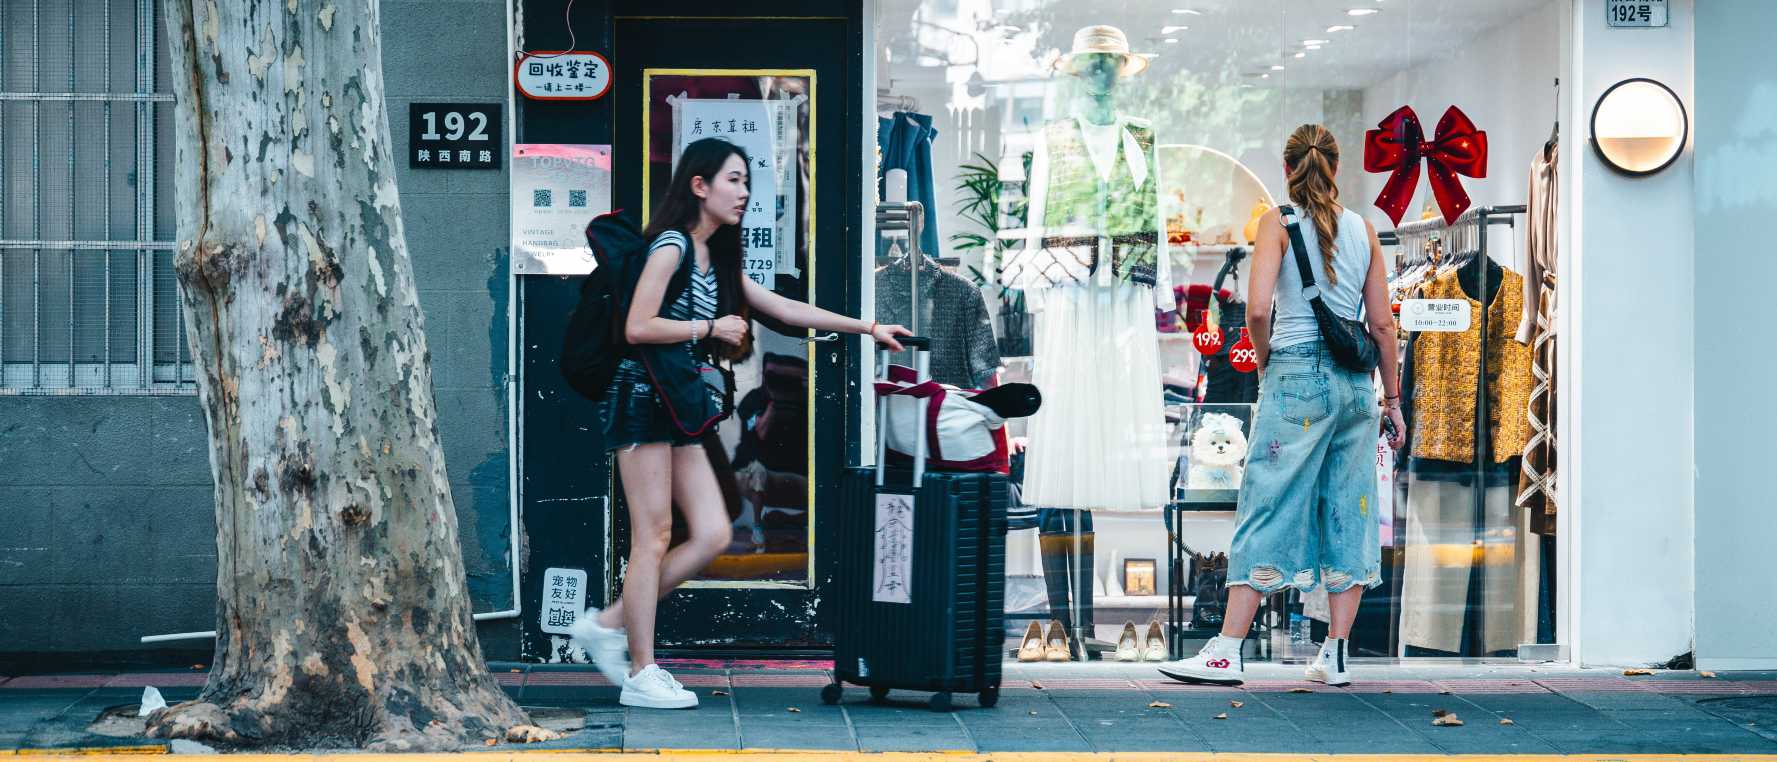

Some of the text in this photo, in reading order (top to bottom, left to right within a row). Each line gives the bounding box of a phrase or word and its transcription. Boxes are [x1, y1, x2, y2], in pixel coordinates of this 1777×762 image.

[1612, 5, 1651, 21] 192号
[529, 60, 598, 78] 回收鉴定
[422, 112, 488, 140] 192
[418, 150, 491, 162] 陕西南路
[552, 576, 577, 587] 宠物
[552, 588, 577, 599] 友好
